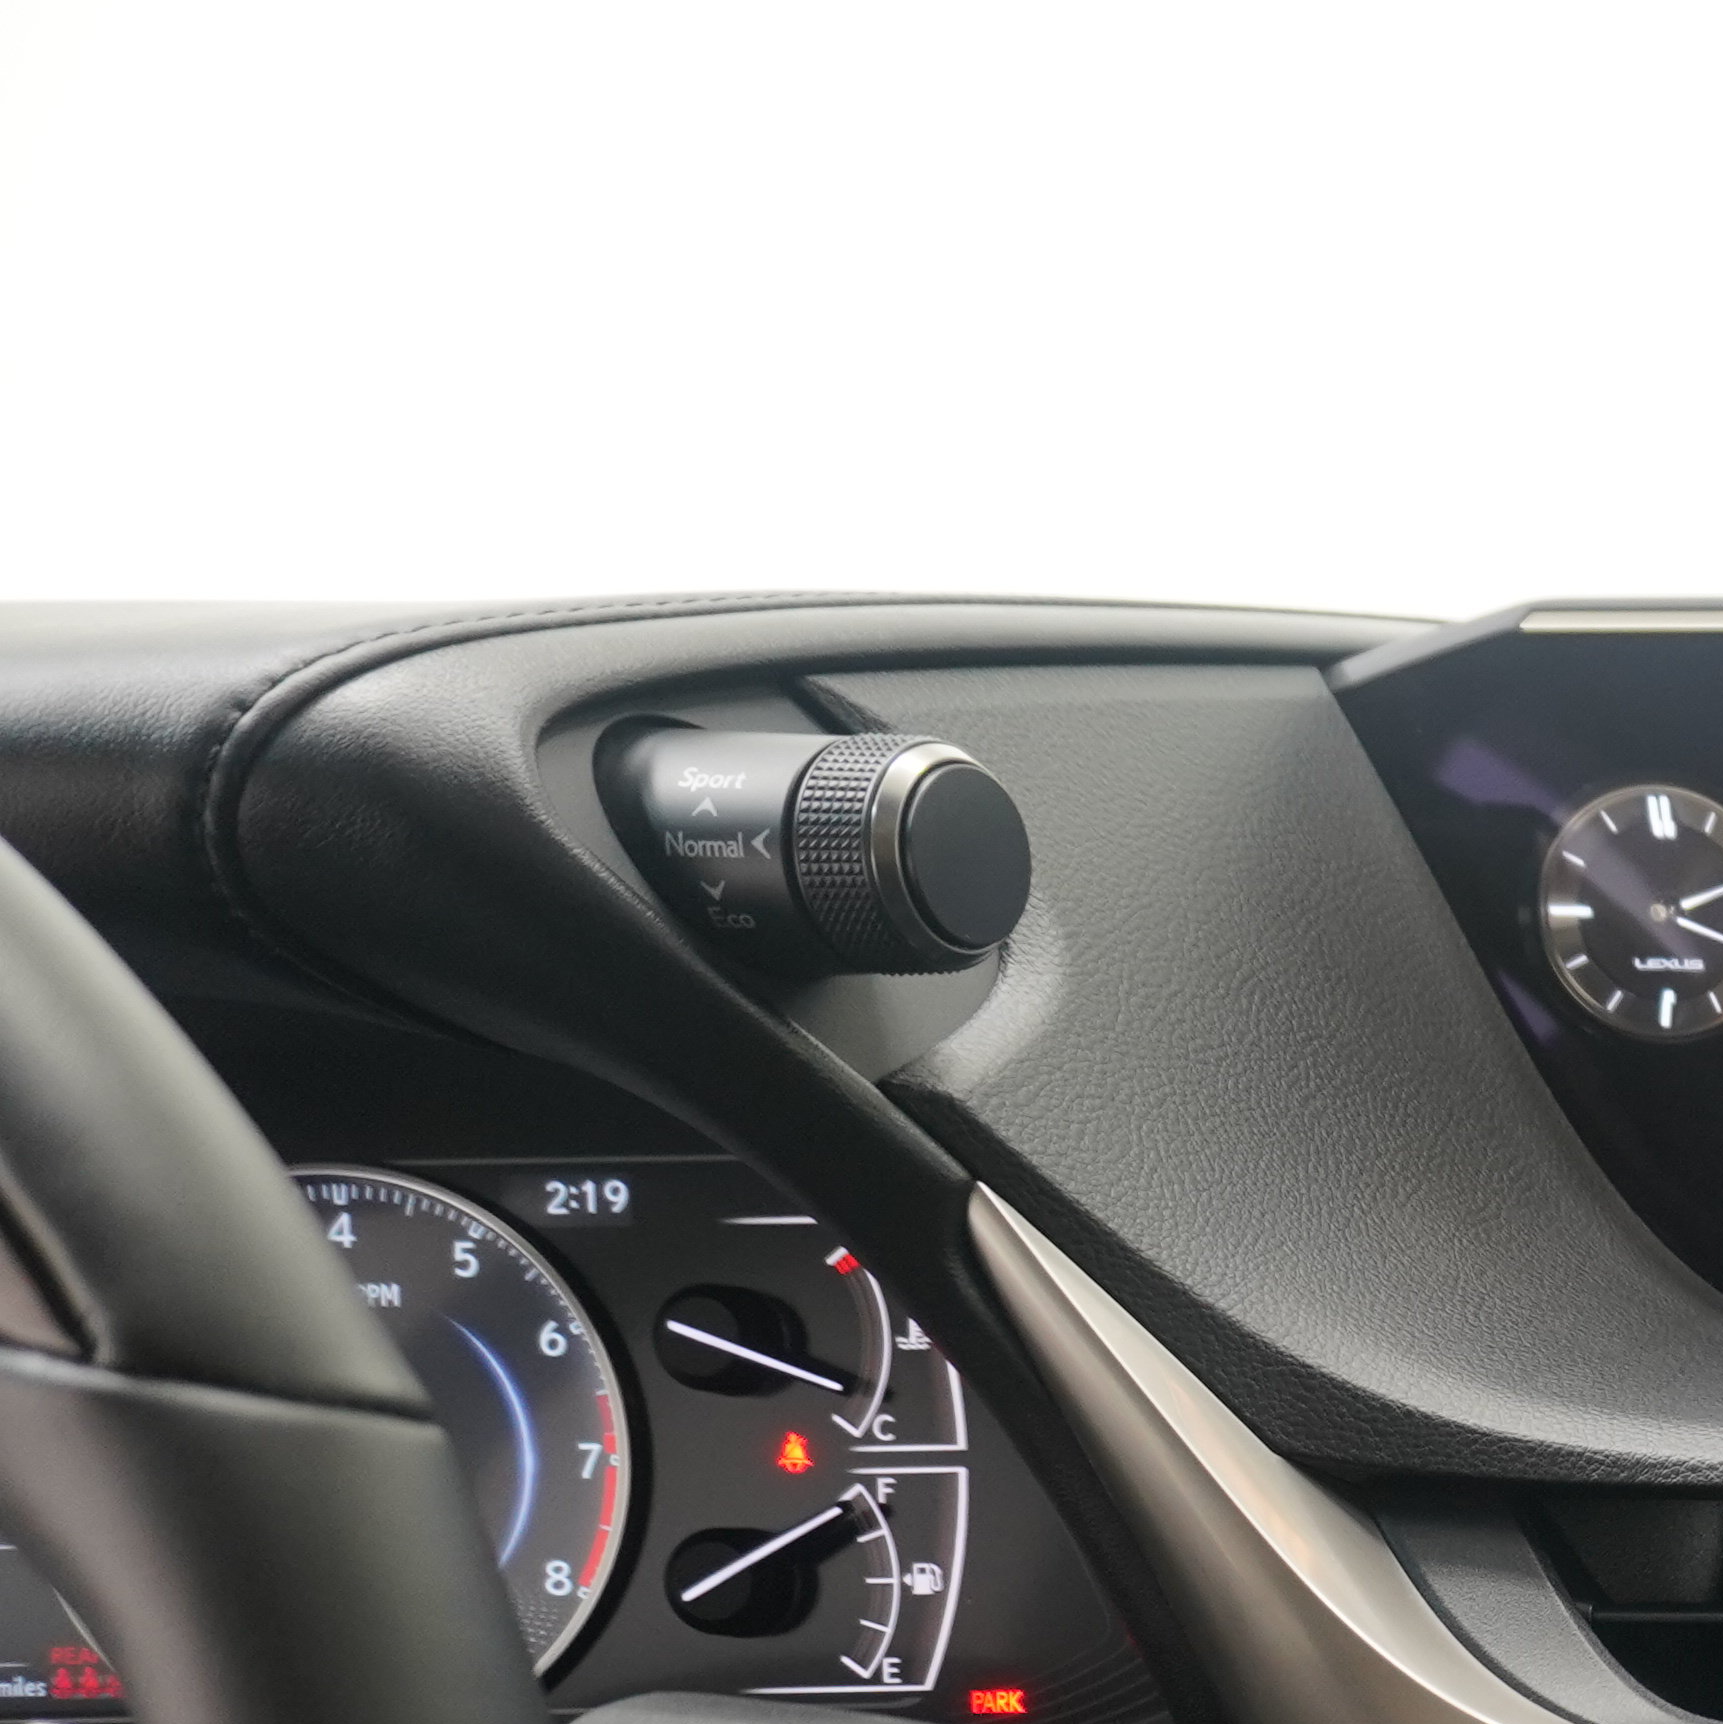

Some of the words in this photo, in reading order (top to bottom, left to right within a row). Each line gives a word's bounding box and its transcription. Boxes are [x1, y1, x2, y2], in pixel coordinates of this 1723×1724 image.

[678, 767, 746, 791] Sport
[666, 826, 749, 858] Normal
[707, 906, 755, 928] Eco
[1634, 957, 1704, 971] LEXUS
[546, 1179, 629, 1215] 2:19
[327, 1212, 357, 1249] 4
[453, 1240, 480, 1278] 5
[539, 1320, 568, 1357] 6
[873, 1414, 897, 1442] C
[578, 1443, 603, 1479] 7
[877, 1477, 897, 1503] F
[545, 1560, 573, 1596] 8
[882, 1656, 902, 1684] E
[0, 1676, 47, 1697] miles
[970, 1689, 1027, 1714] PARK
